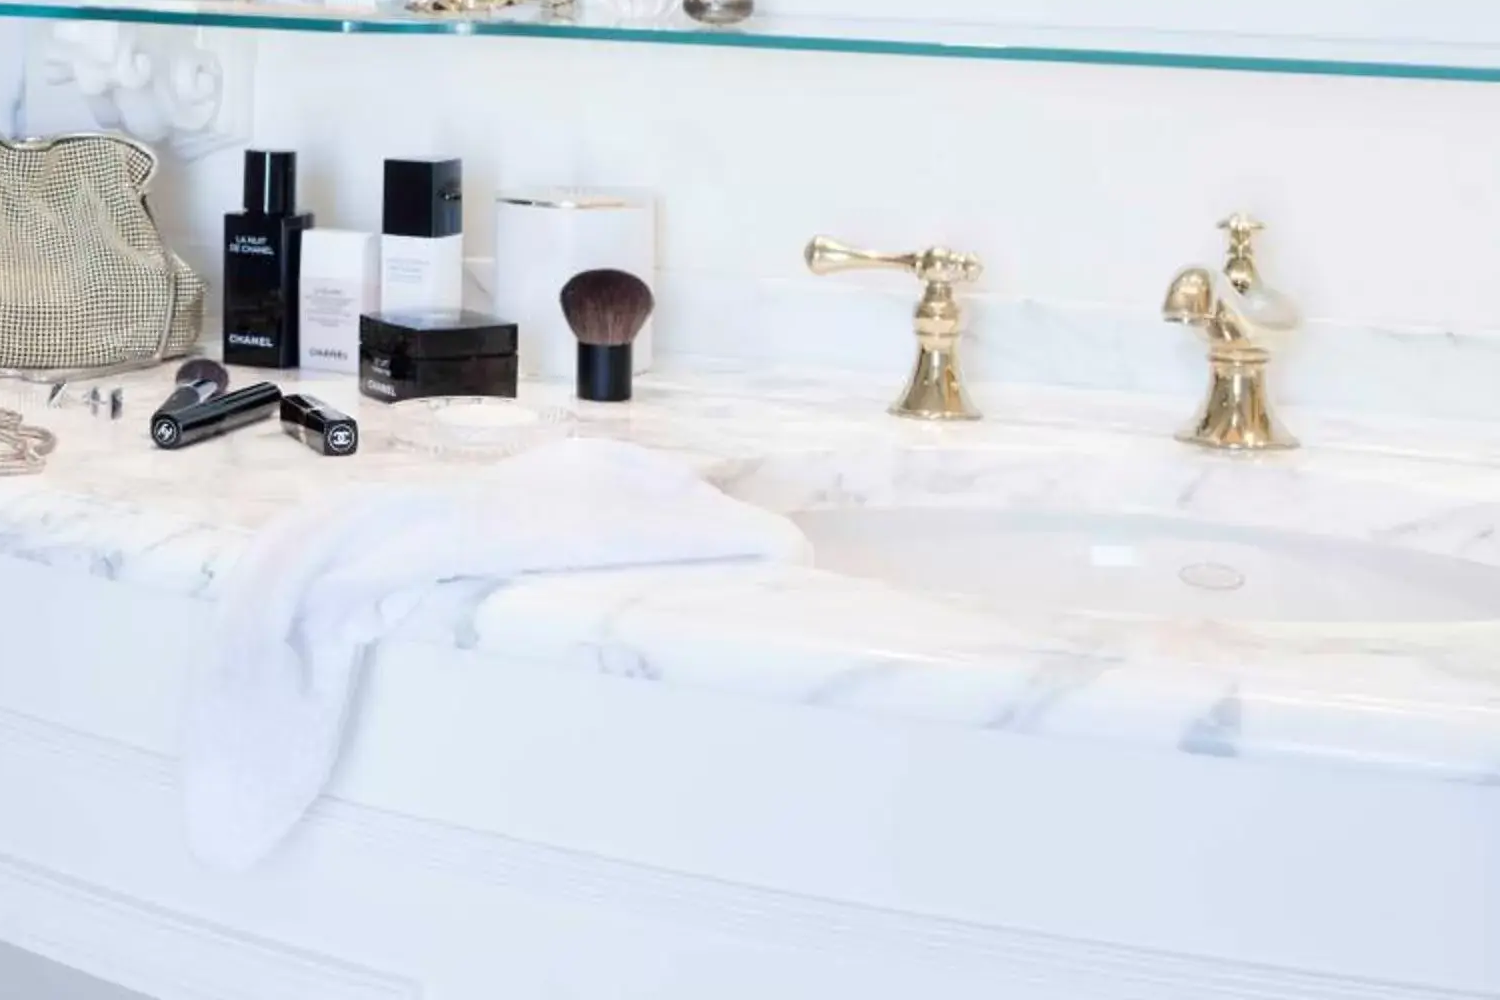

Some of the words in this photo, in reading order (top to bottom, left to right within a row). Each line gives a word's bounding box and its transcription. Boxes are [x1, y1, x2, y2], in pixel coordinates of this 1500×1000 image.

[235, 235, 247, 244] LA
[247, 235, 268, 245] NUIT
[229, 243, 240, 253] DE
[241, 245, 275, 255] CHANEL
[229, 334, 274, 347] CHANEL
[309, 347, 348, 360] CHANEL
[367, 380, 397, 397] CHANEL
